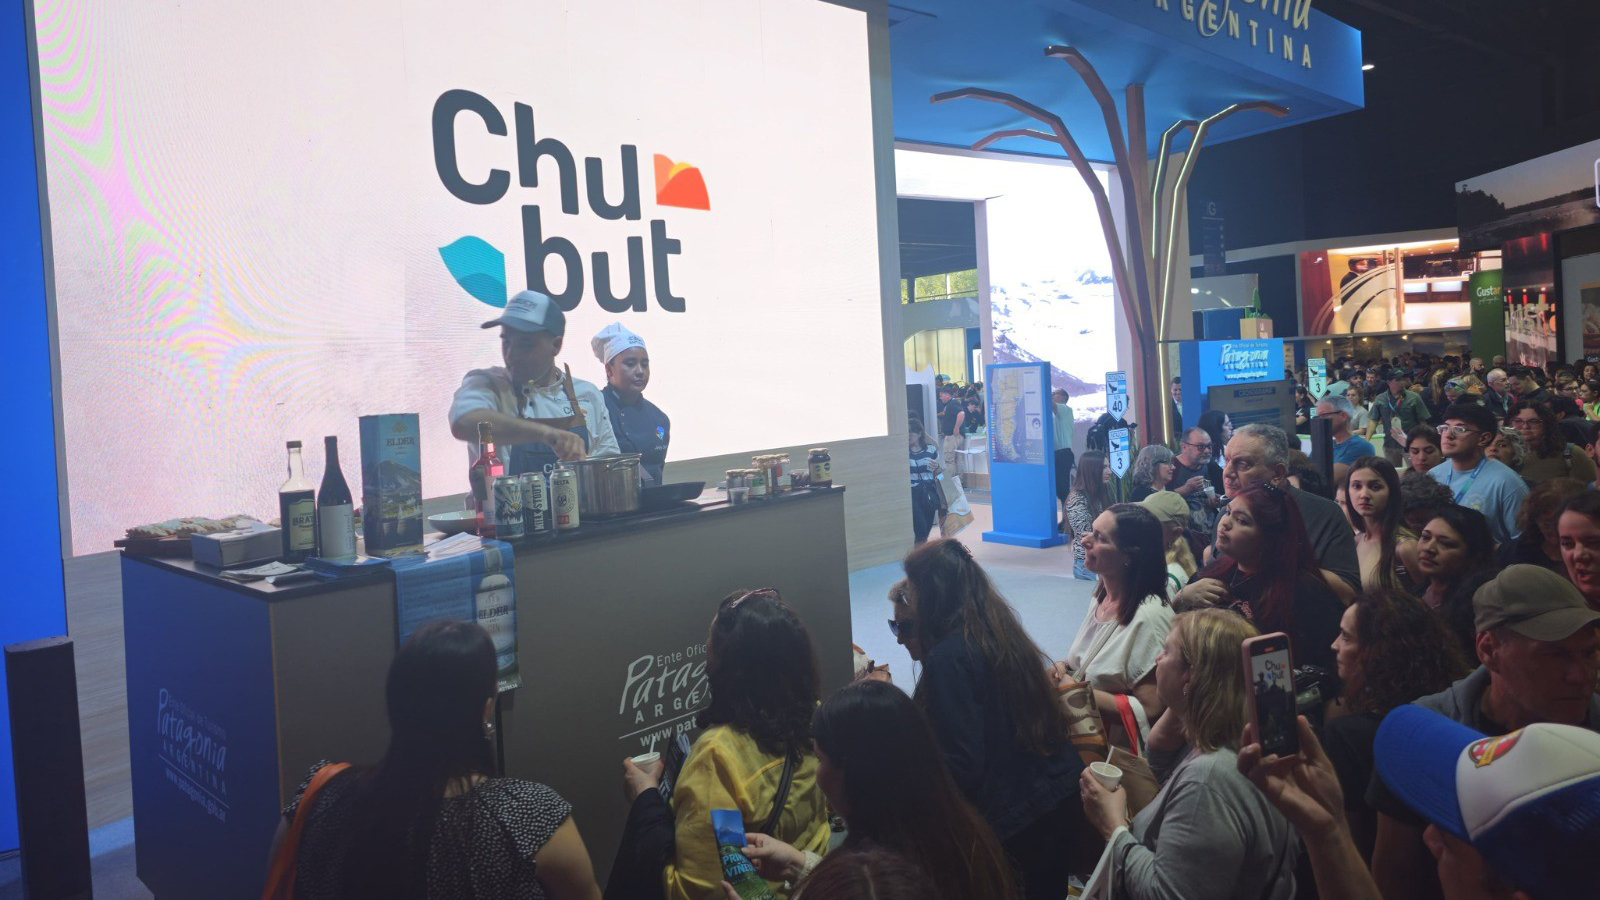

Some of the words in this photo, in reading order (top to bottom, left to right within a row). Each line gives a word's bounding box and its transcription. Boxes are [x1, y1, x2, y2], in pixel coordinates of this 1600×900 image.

[1139, 0, 1312, 69] GENTINA
[432, 89, 641, 221] Chu
[521, 205, 686, 314] but
[1476, 285, 1501, 297] Gustar
[1315, 383, 1321, 393] 3
[1112, 400, 1123, 412] 40
[386, 436, 415, 447] ELDER
[1117, 457, 1123, 470] 3
[531, 483, 543, 510] STOUT
[533, 510, 545, 531] MILK
[478, 604, 509, 620] ELDER
[657, 652, 682, 667] Ente
[1265, 660, 1282, 671] Chu
[157, 687, 228, 772] Patagonia
[640, 716, 697, 747] wwwpat
